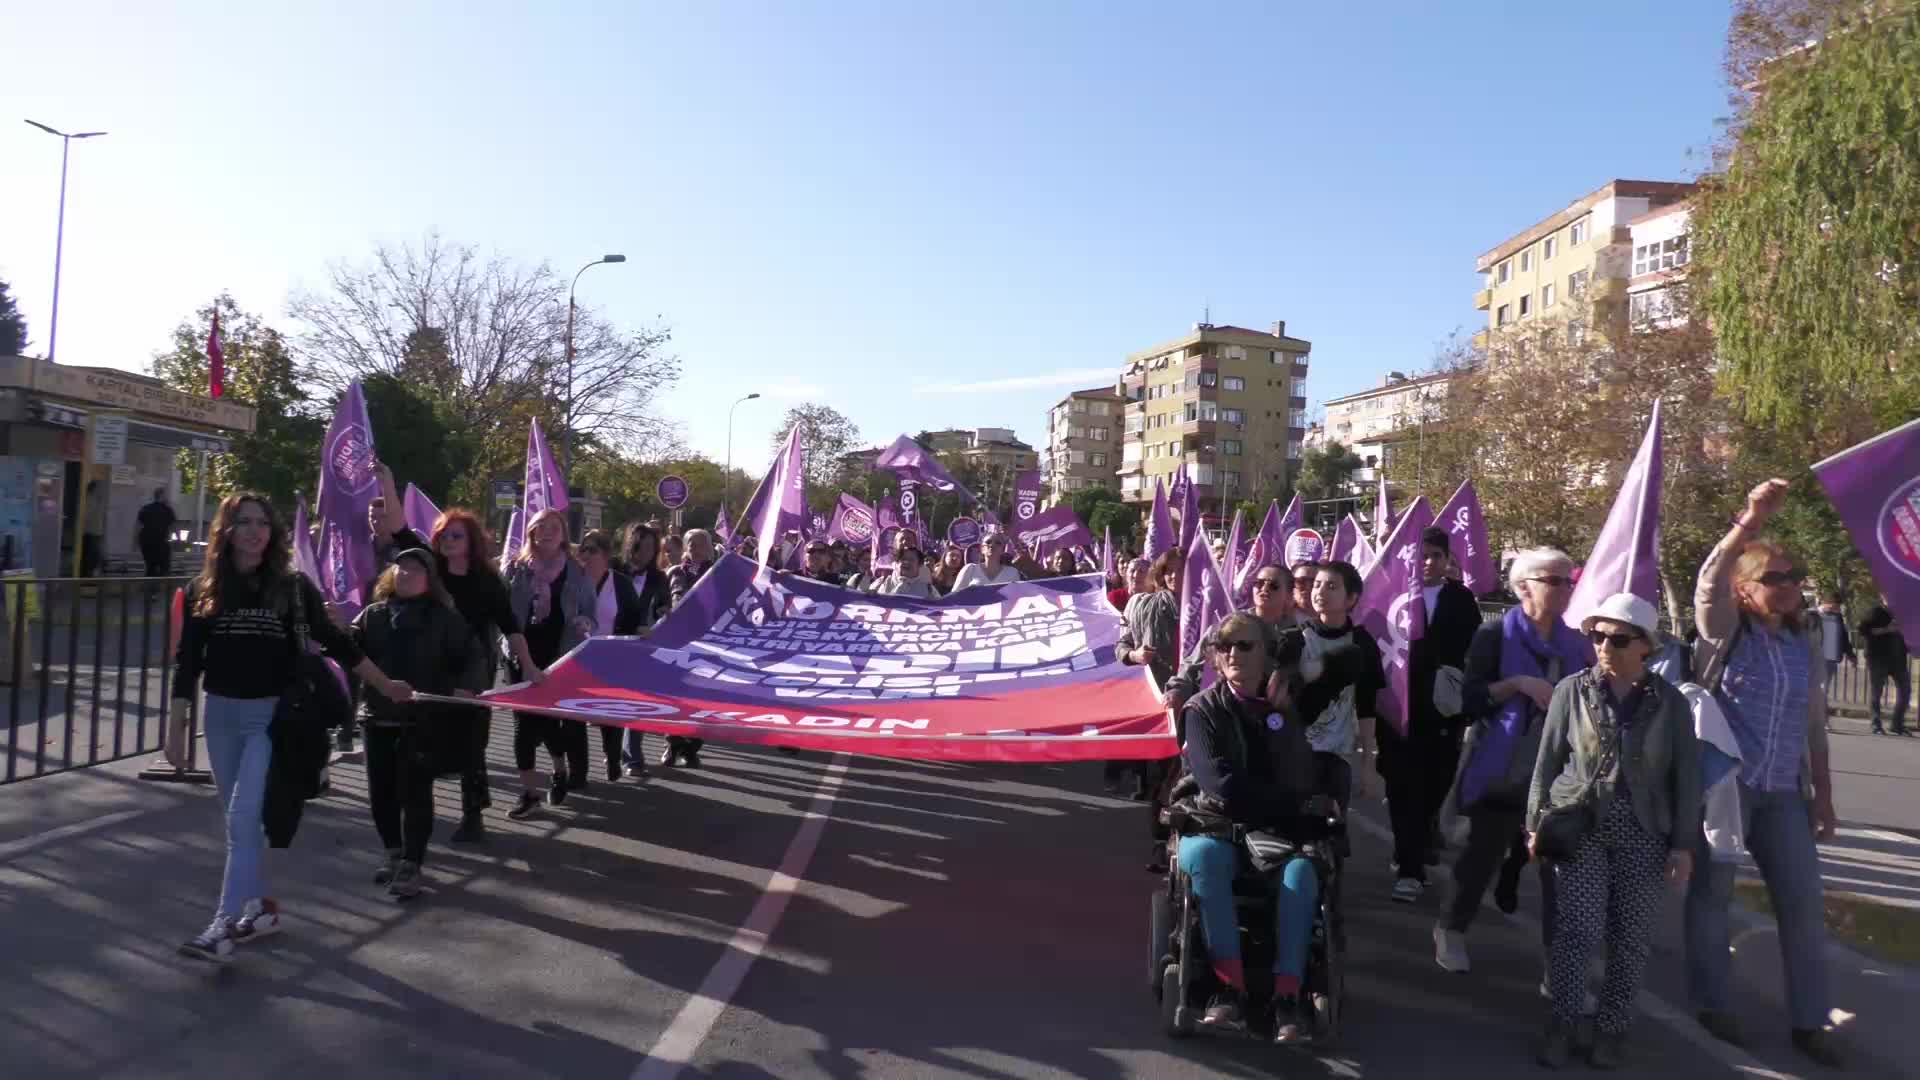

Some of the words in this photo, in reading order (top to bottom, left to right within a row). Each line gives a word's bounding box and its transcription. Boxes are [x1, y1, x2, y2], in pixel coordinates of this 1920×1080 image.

[683, 631, 1088, 674] KADIN
[775, 686, 960, 699] VAR!
[689, 711, 930, 728] KADIN
